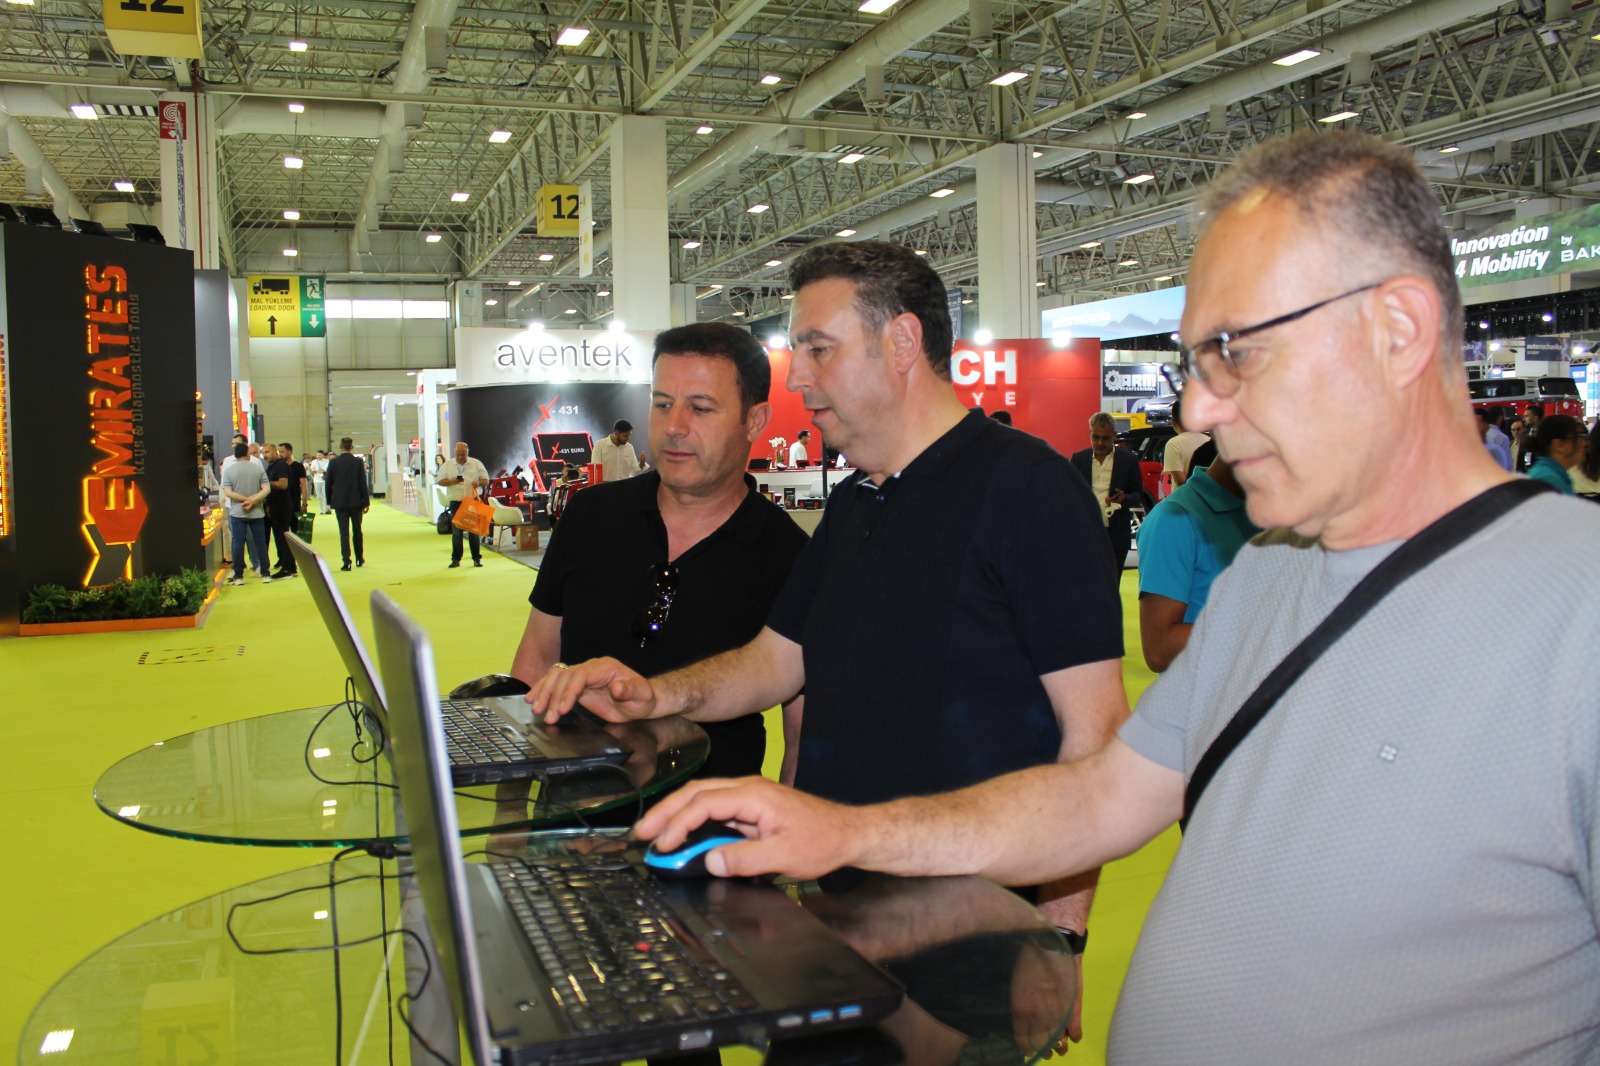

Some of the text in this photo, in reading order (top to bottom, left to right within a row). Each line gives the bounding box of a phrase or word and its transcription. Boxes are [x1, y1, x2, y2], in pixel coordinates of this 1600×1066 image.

[550, 194, 580, 220] 12
[1450, 224, 1550, 257] Innovation
[1560, 235, 1573, 247] by
[1454, 248, 1551, 279] 4 Mobility
[497, 338, 632, 367] aventek
[83, 264, 149, 546] EMIRATES
